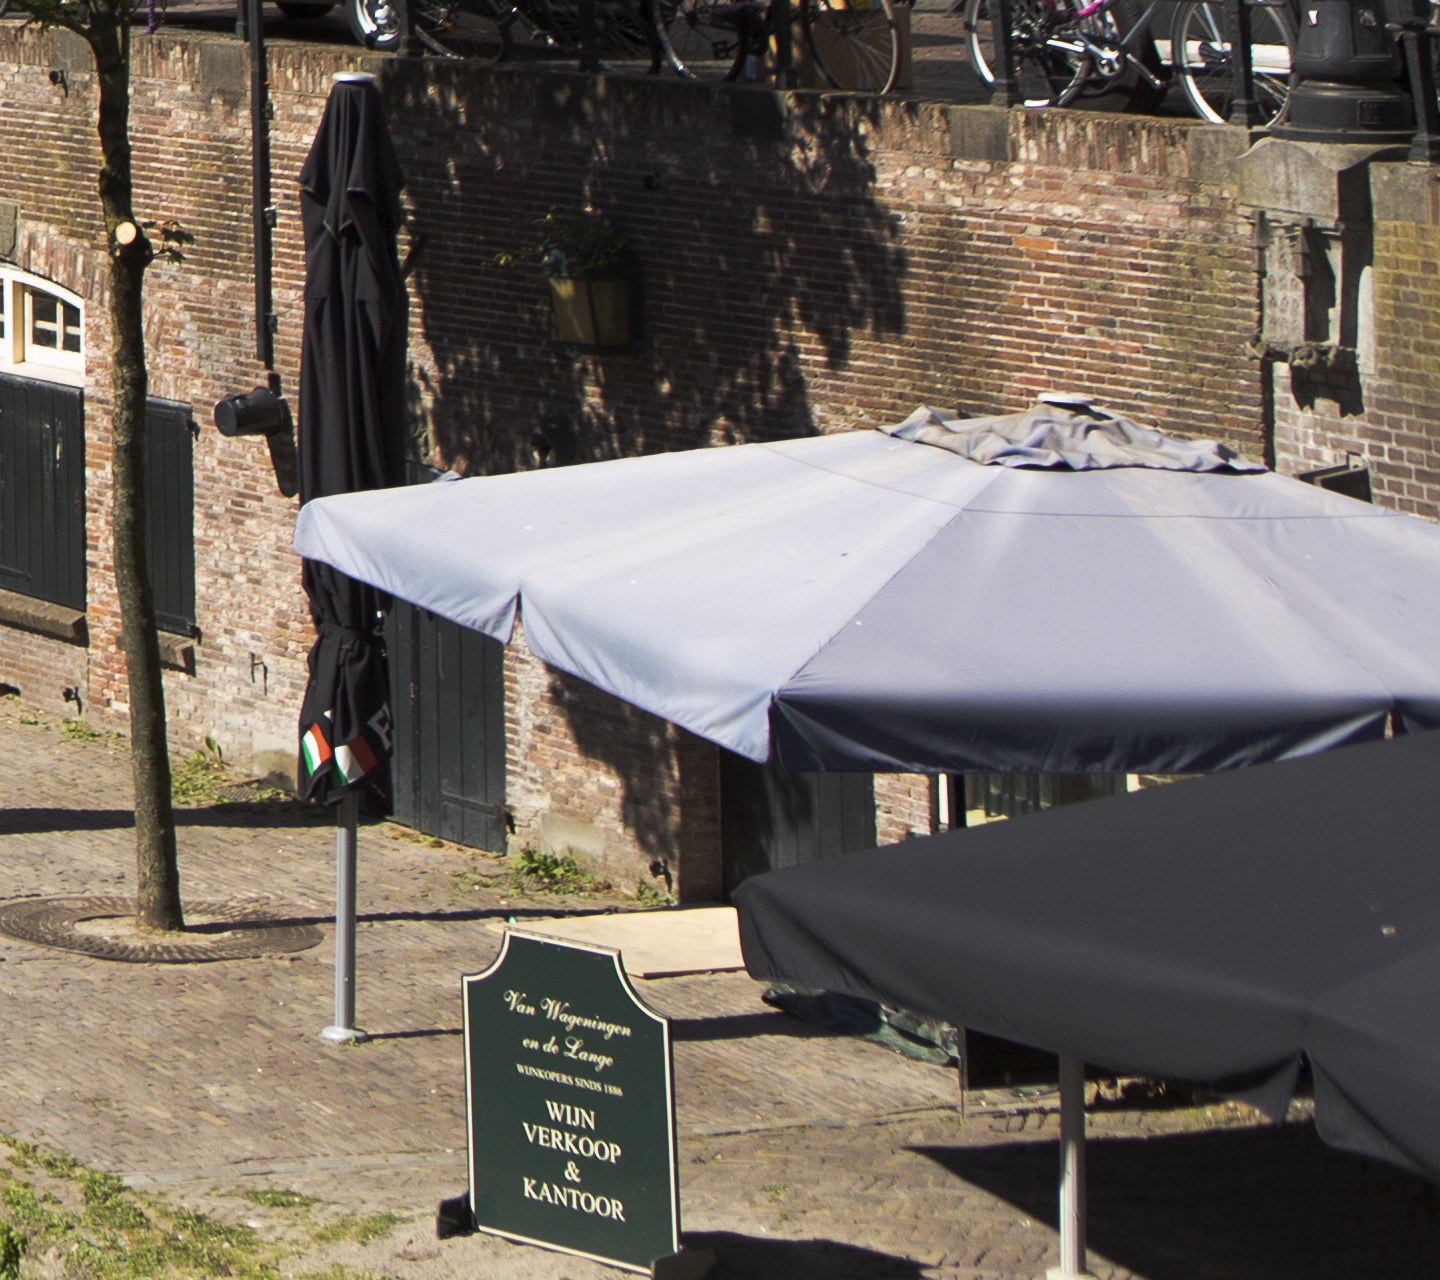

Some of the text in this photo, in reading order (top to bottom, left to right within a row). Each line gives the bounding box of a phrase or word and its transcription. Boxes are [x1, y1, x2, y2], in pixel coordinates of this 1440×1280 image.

[502, 989, 632, 1041] Van Wageningen
[522, 1035, 614, 1073] en de Lange
[515, 1062, 574, 1086] WIJNKOPERS
[574, 1076, 603, 1093] SINDS
[544, 1099, 596, 1131] WIJN
[522, 1121, 622, 1164] VERKOOP
[564, 1160, 582, 1183] &
[522, 1175, 626, 1223] KANTOOR
